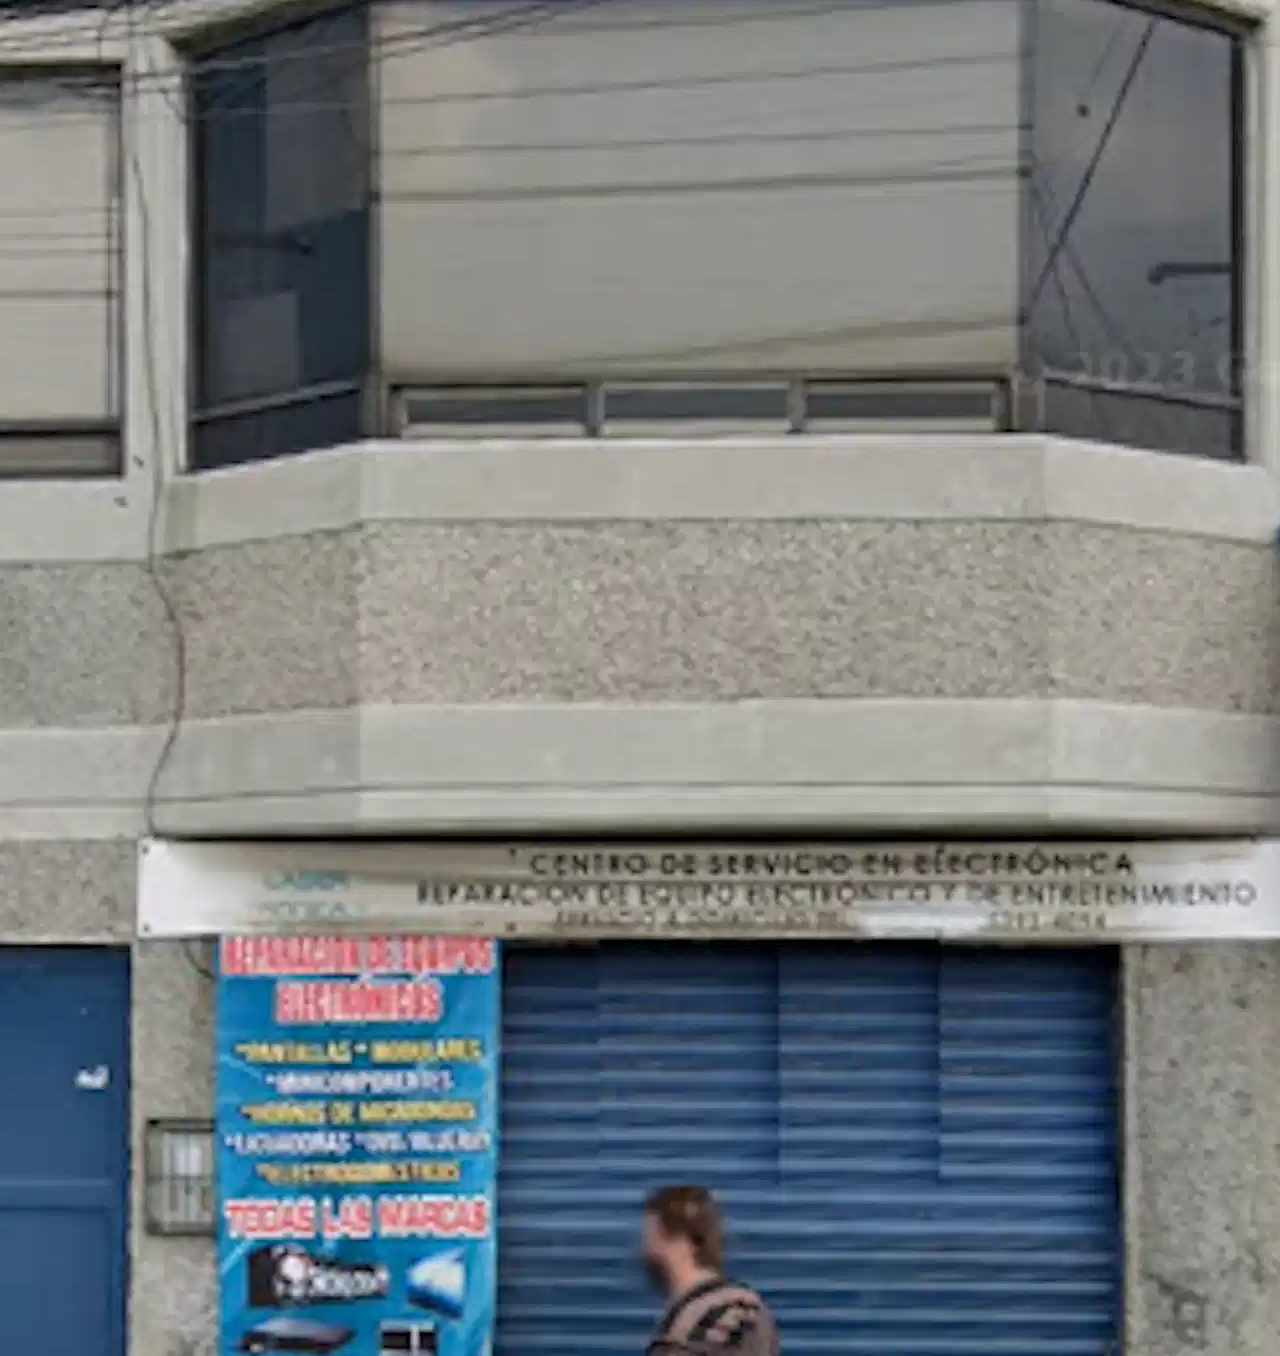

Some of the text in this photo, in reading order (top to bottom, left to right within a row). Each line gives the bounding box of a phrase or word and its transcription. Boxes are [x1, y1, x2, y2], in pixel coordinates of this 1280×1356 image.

[529, 852, 650, 875] CENTRO
[660, 852, 698, 875] DE
[708, 852, 854, 875] SERVICIO
[865, 852, 902, 875] EN
[1011, 882, 1258, 907] ENTRETENIMIENTO
[224, 1194, 490, 1239] TODAS LAS MARCAS
